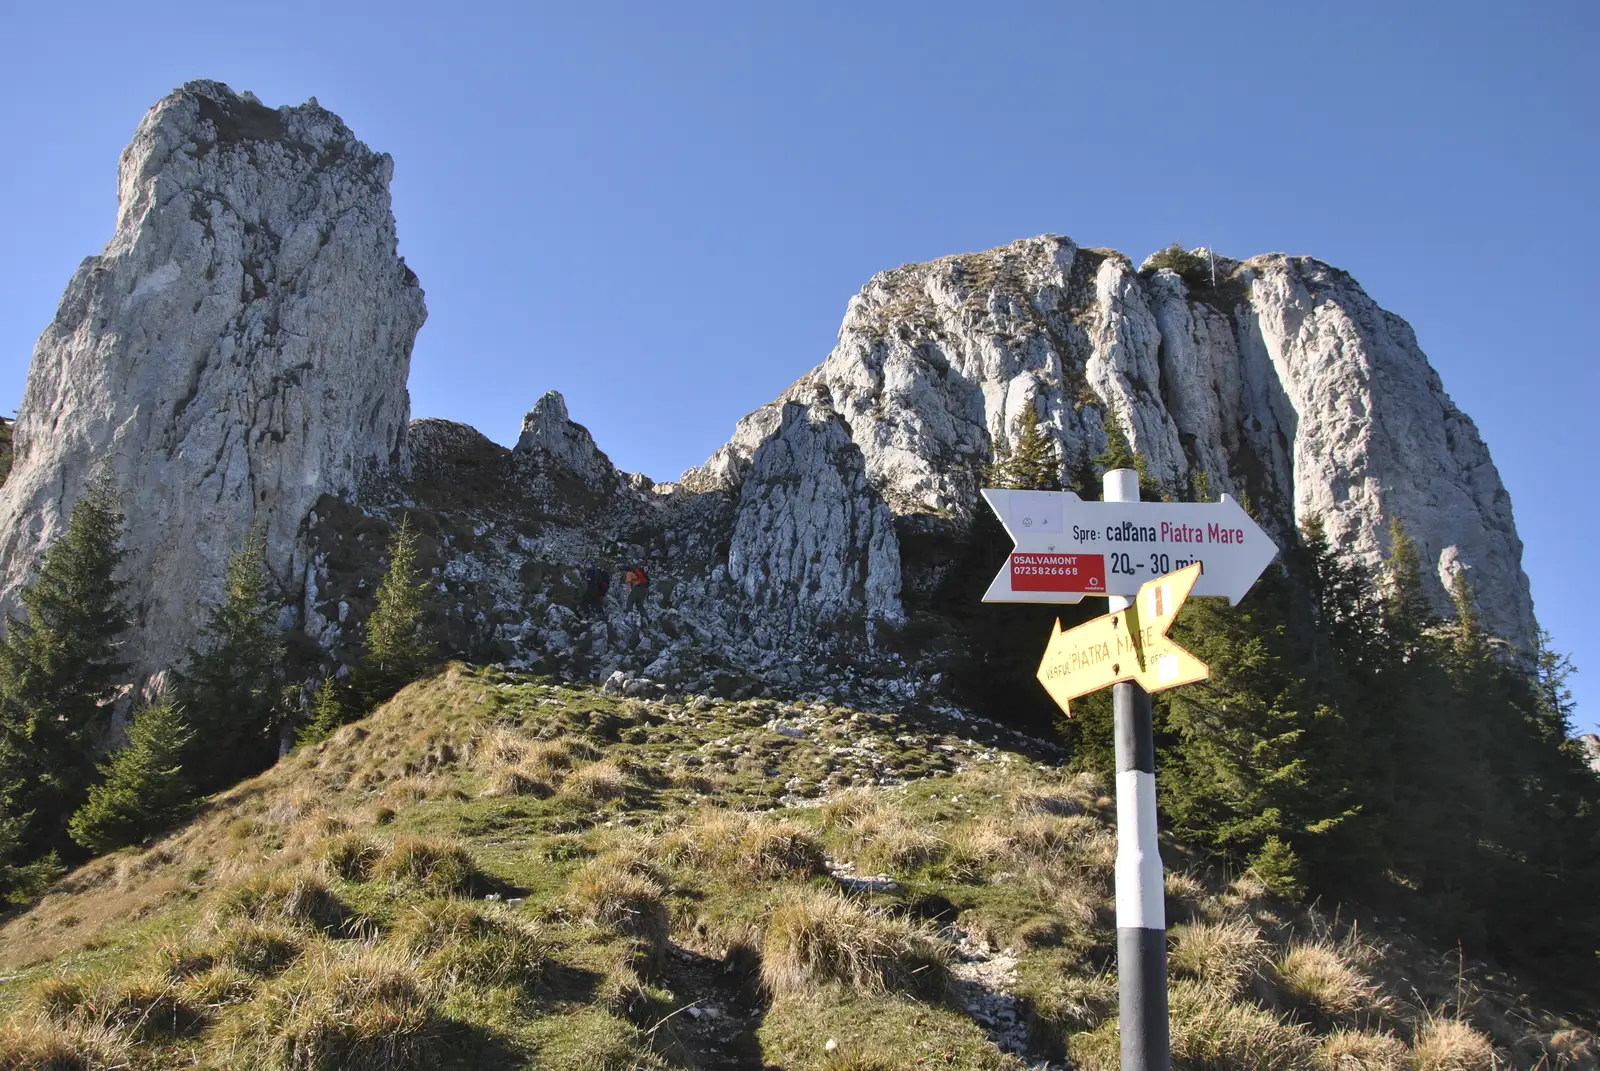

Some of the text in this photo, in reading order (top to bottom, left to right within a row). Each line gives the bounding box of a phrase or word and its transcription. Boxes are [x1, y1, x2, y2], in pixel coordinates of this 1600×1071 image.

[1073, 521, 1244, 544] Spre: cabana Piatra Mare
[1014, 566, 1078, 576] 0725826668
[1111, 553, 1131, 574] 20
[1150, 553, 1169, 575] 30
[1071, 641, 1110, 671] PIATRA
[1117, 626, 1155, 657] MARE
